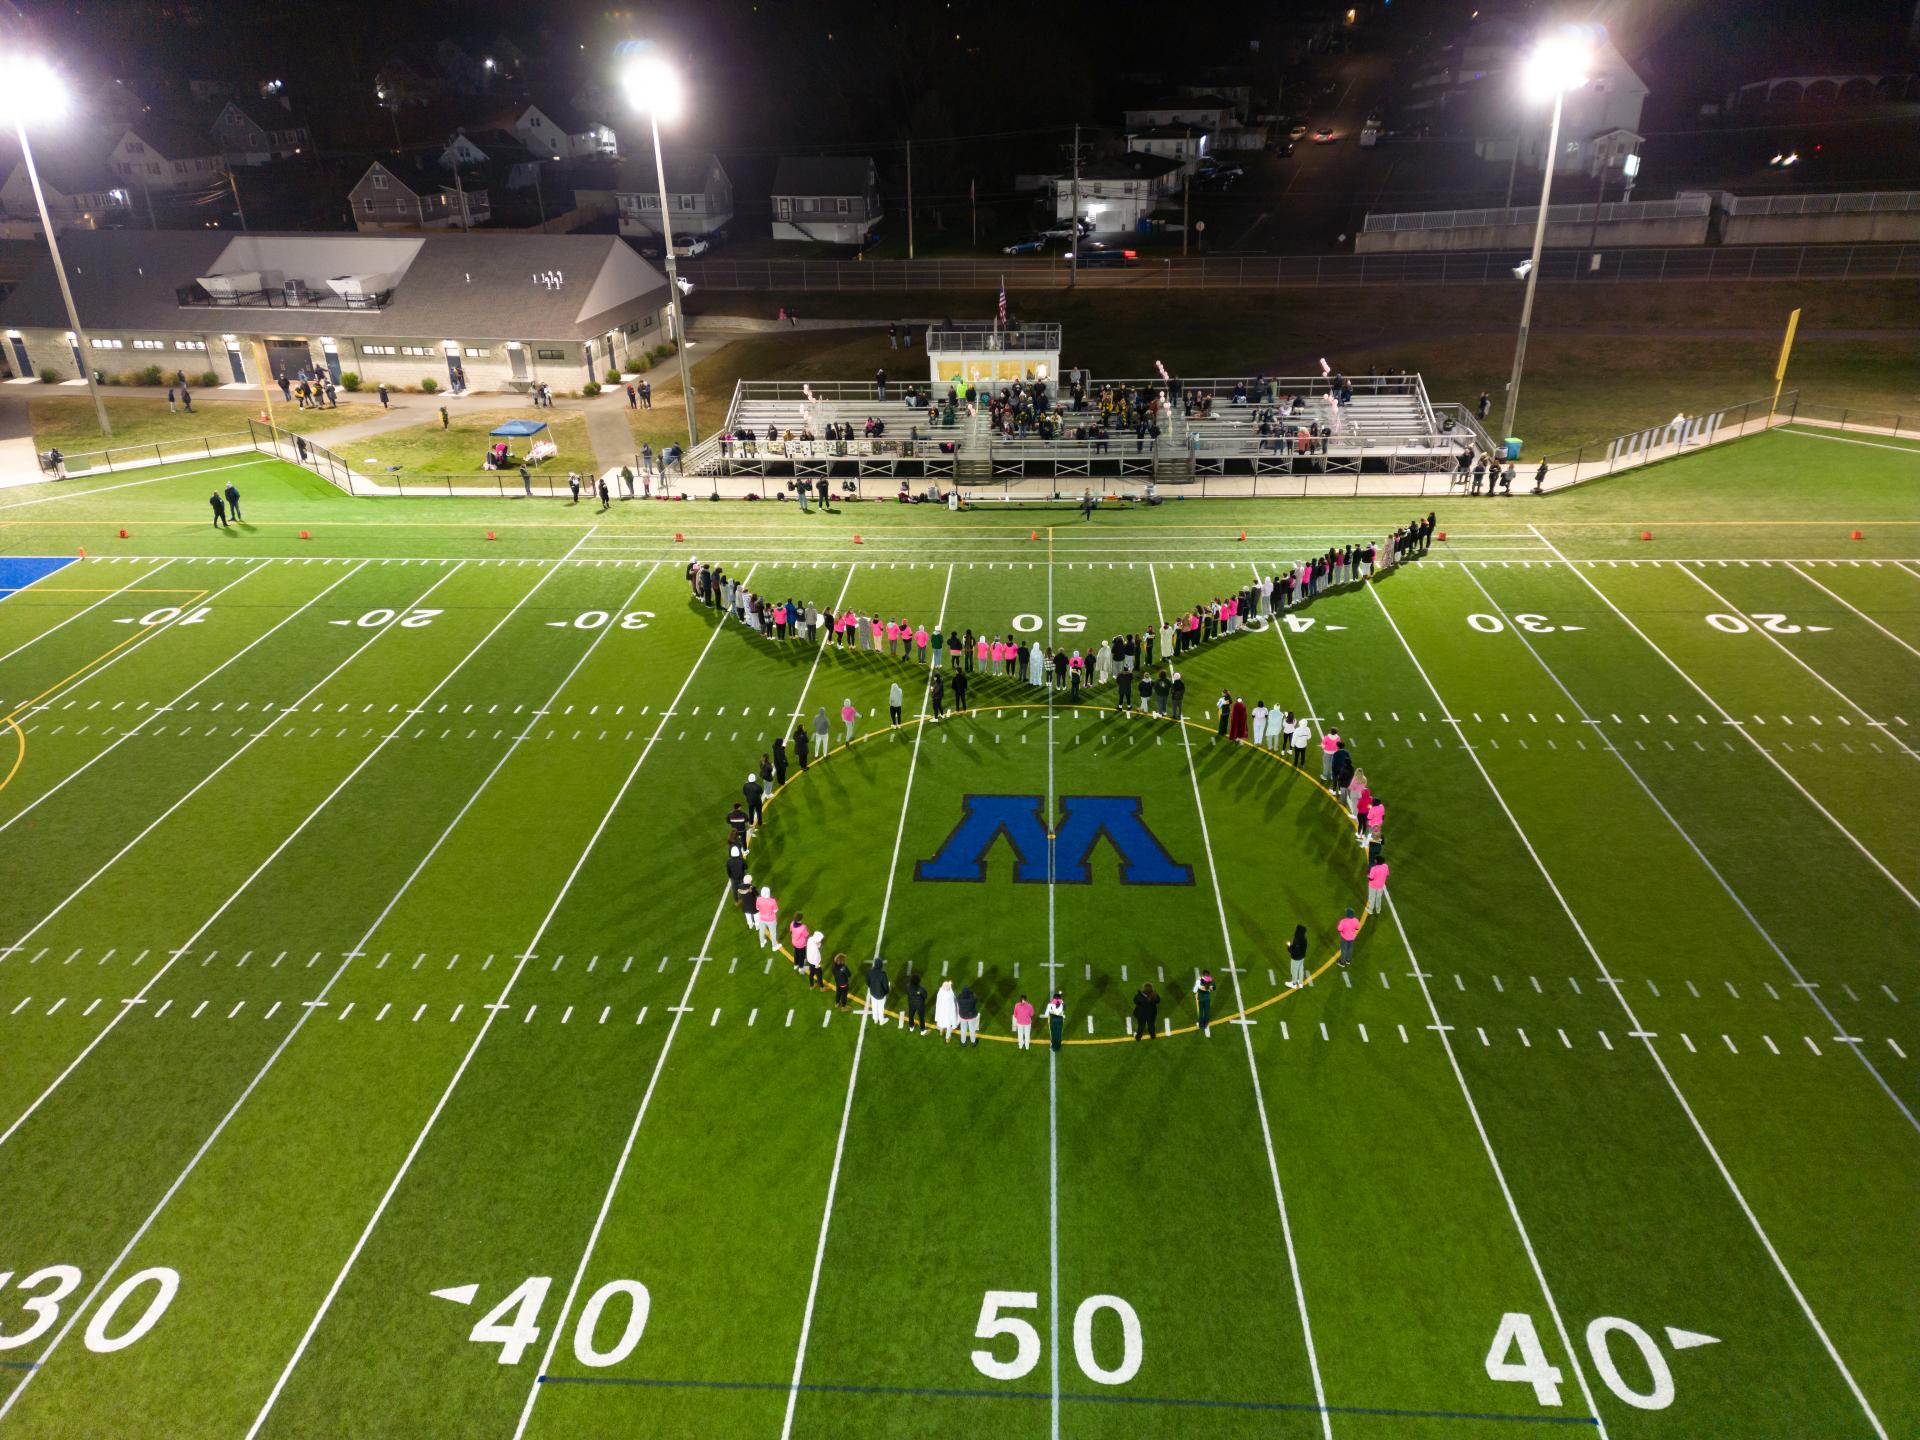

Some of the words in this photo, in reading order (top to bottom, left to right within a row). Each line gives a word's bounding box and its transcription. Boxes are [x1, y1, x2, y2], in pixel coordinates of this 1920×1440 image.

[139, 607, 212, 626] 10
[357, 608, 444, 628] 20
[573, 610, 656, 630] 30
[1012, 614, 1088, 633] 50
[1466, 613, 1556, 633] 30
[1705, 613, 1802, 634] 20
[0, 1265, 180, 1353] 30
[468, 1276, 651, 1368] 40
[970, 1290, 1143, 1385] 50
[1485, 1312, 1675, 1410] 40
